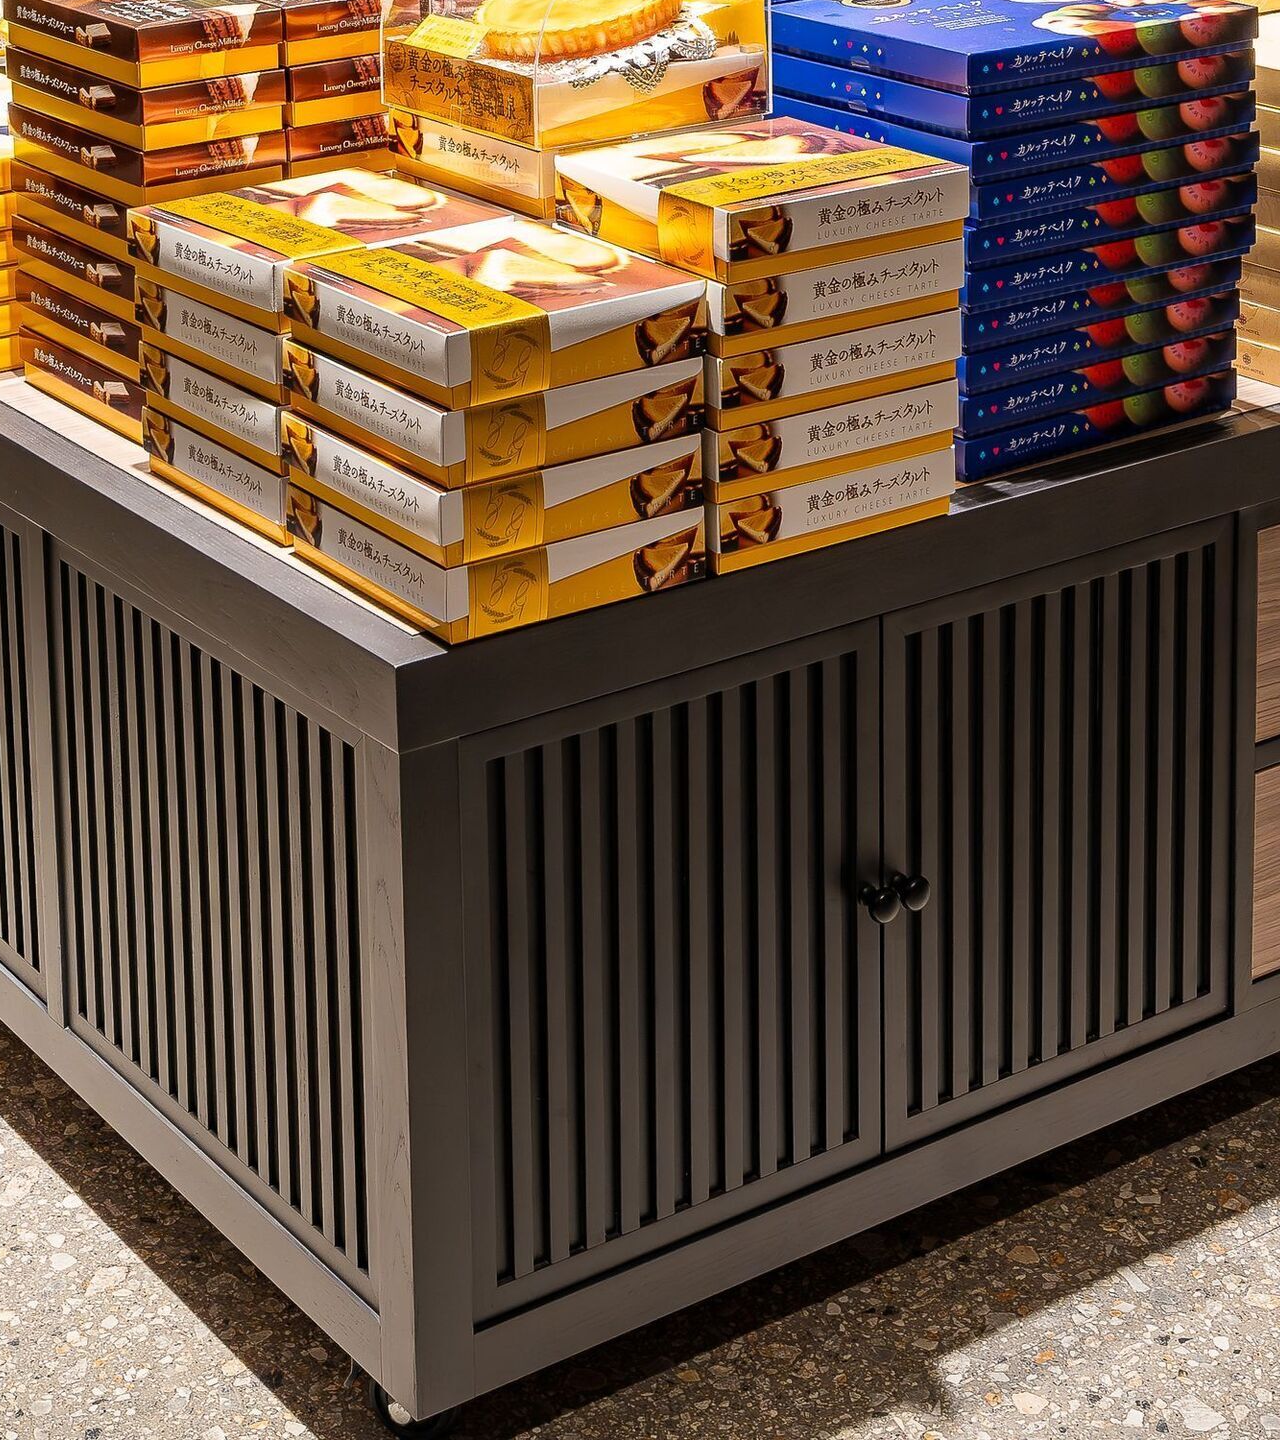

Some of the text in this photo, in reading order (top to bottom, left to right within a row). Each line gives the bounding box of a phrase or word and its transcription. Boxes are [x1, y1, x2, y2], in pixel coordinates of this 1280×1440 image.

[171, 43, 193, 53] Luxury
[195, 40, 217, 50] Cheese
[410, 74, 461, 104] チーズタルト
[176, 106, 198, 115] Luxury
[199, 103, 221, 113] Cheese
[320, 143, 341, 153] Luxury
[343, 139, 364, 149] Cheese
[438, 136, 520, 172] 黄金の極みチーズタルト
[176, 166, 198, 177] Luxury
[199, 163, 221, 173] Cheese
[818, 187, 944, 226] 黄金の極みチーズタルト
[818, 208, 944, 240] LUXURY CHEESE TARTE
[174, 242, 254, 284] 黄金の極みチーズタルト
[813, 259, 939, 299] 黄金の極みチーズタルト
[813, 279, 939, 313] LUXURY CHEESE TARTE
[181, 310, 258, 355] 黄金の極みチーズタルト
[336, 305, 425, 356] 黄金の極みチーズタルト
[810, 329, 936, 371] 黄金の極みチーズタルト
[810, 349, 936, 385] LUXURY CHEESE TARTE
[183, 378, 258, 425] 黄金の極みチーズタルト
[335, 379, 421, 430] 黄金の極みチーズタルト
[808, 400, 933, 443] 黄金の極みチーズタルト
[808, 421, 932, 457] LUXURY CHEESE TARTE
[188, 444, 262, 495] 黄金の極みチーズタルト
[333, 455, 419, 511] 黄金の極みチーズタルト
[806, 487, 930, 526] LUXURY CHEESE TARTE
[807, 467, 930, 513] 黄金の極みチーズタルト
[338, 528, 424, 584] 黄金の極みチーズタルト
